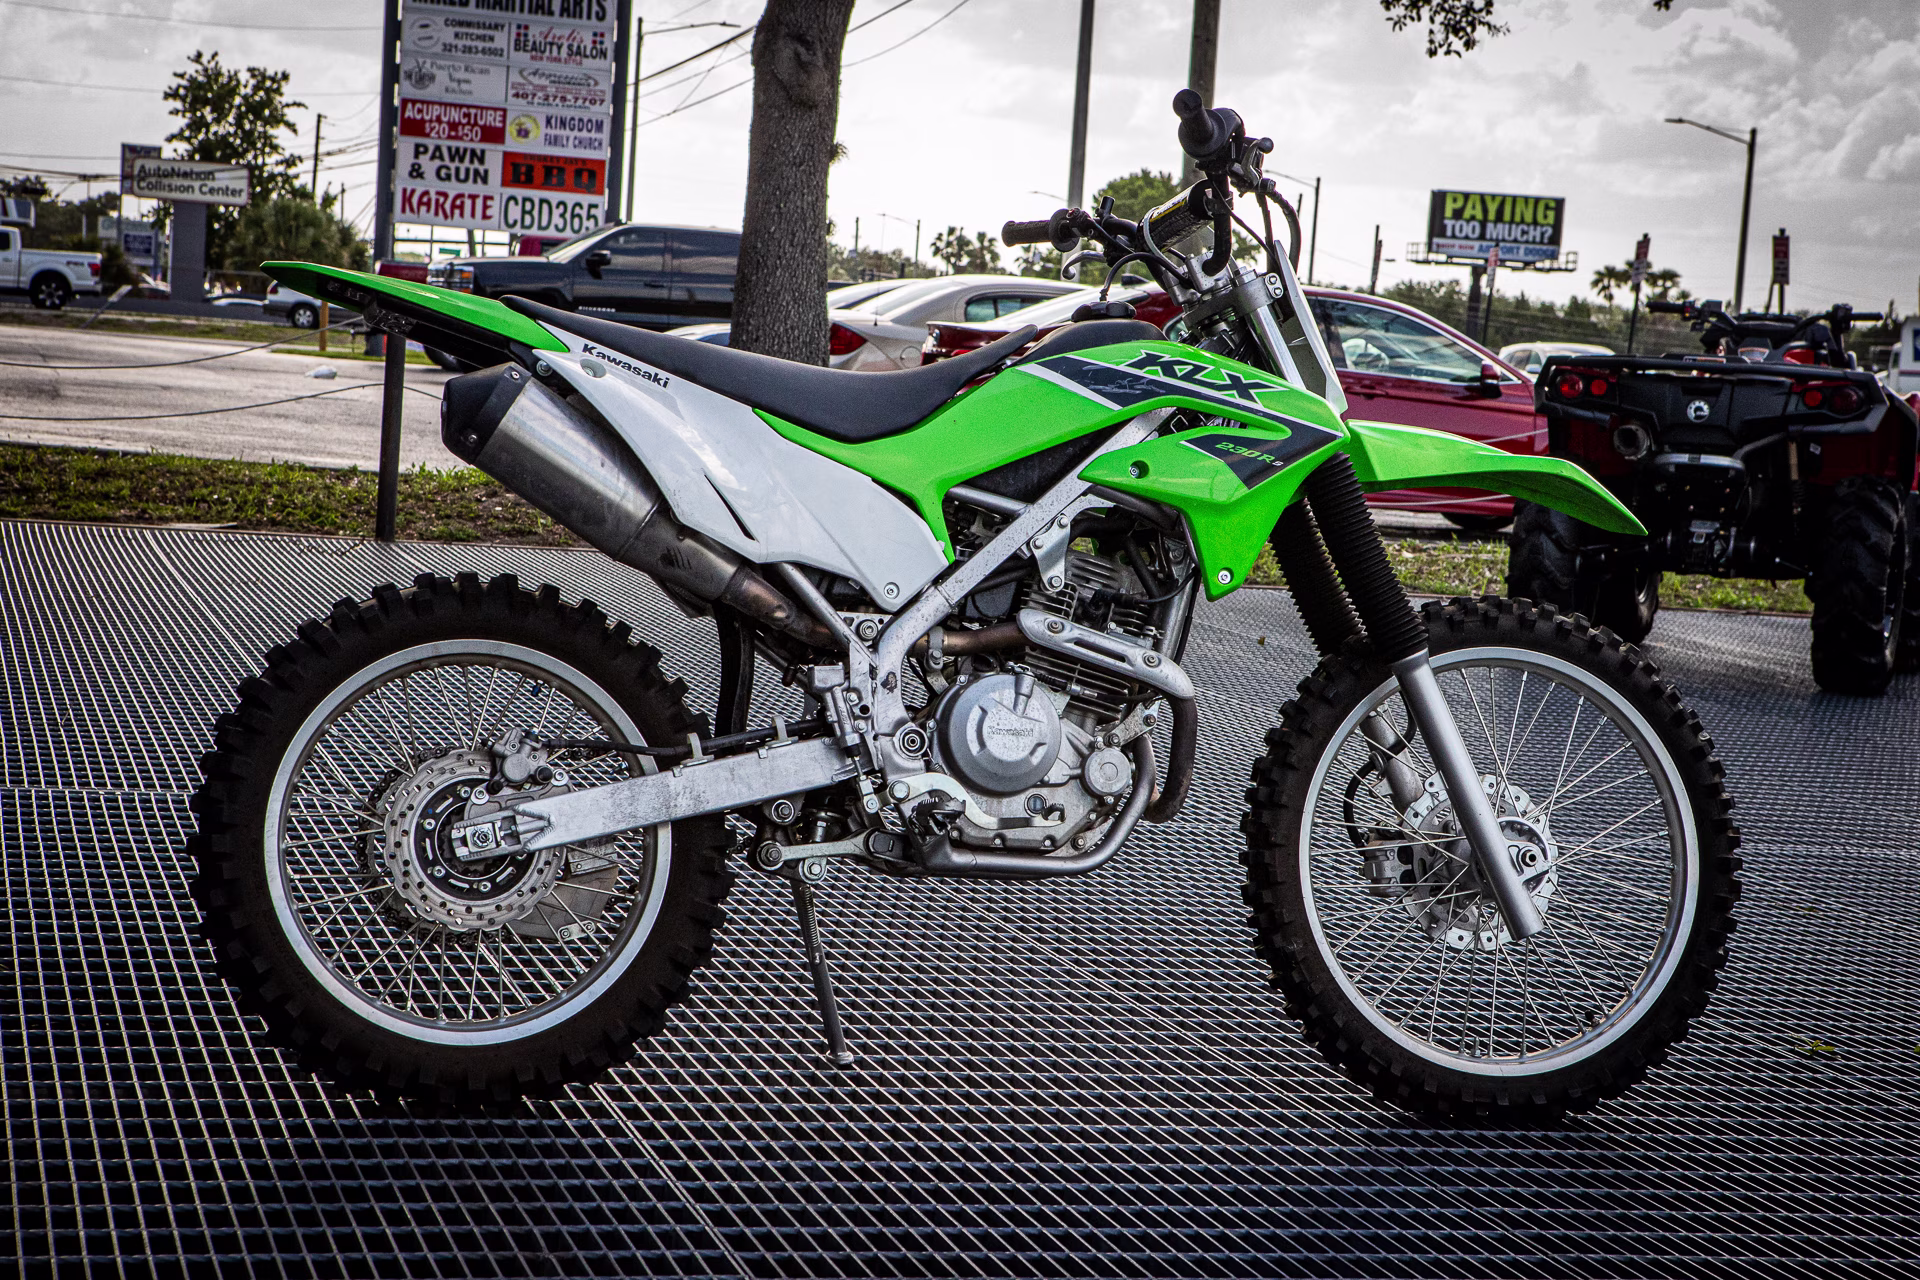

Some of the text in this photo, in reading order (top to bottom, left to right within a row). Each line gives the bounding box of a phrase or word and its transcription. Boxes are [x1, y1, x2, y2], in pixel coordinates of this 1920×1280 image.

[444, 17, 505, 32] COMMISSARY
[454, 32, 495, 43] KITCHEN
[514, 39, 608, 60] BEAUTY SALON
[404, 101, 504, 127] ACUPUNCTURE
[545, 115, 604, 134] KINGDOM
[544, 133, 603, 151] FAMILY CHURCH
[414, 143, 486, 166] PAWN
[137, 164, 216, 181] AutoNation
[408, 162, 489, 185] & GUN
[510, 162, 597, 194] BBQ
[136, 179, 245, 198] Collision Center
[401, 187, 494, 221] KARATE
[504, 195, 599, 234] CBD365
[1444, 192, 1556, 225] PAYING
[1443, 219, 1553, 244] TOO MUCH?
[1477, 244, 1522, 257] AIORT
[582, 343, 670, 388] Kawasaki
[1120, 350, 1288, 405] KLX
[986, 725, 1034, 738] Kawasaki
